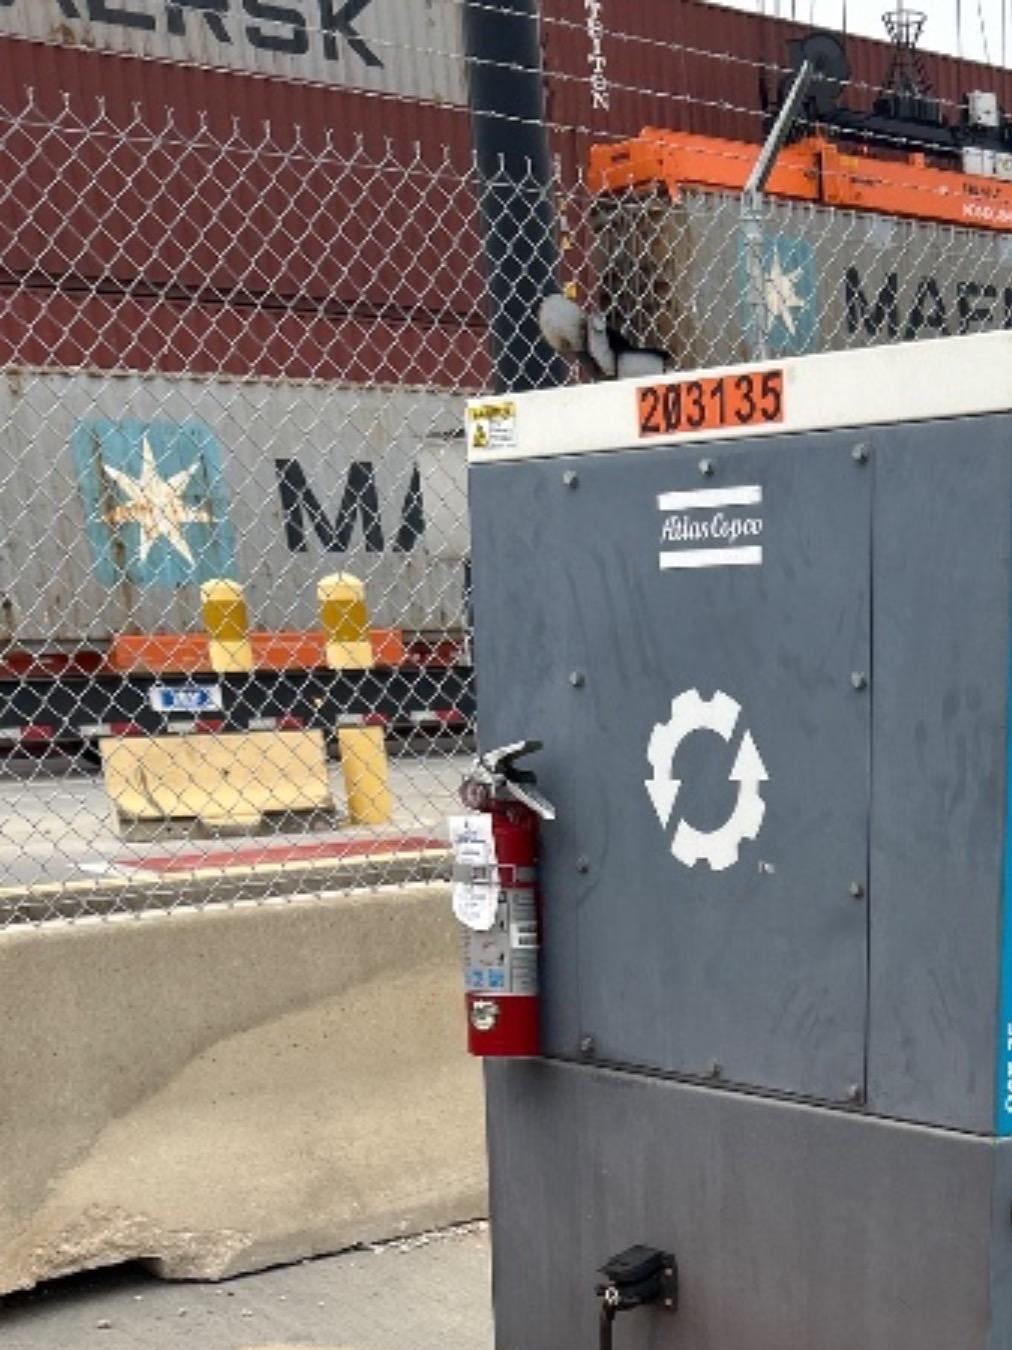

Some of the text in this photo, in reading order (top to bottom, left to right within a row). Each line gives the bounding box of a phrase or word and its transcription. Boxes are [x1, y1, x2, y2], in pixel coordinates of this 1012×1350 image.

[0, 0, 384, 69] RSK
[640, 370, 781, 433] 203135
[661, 512, 762, 543] Atlas Copco
